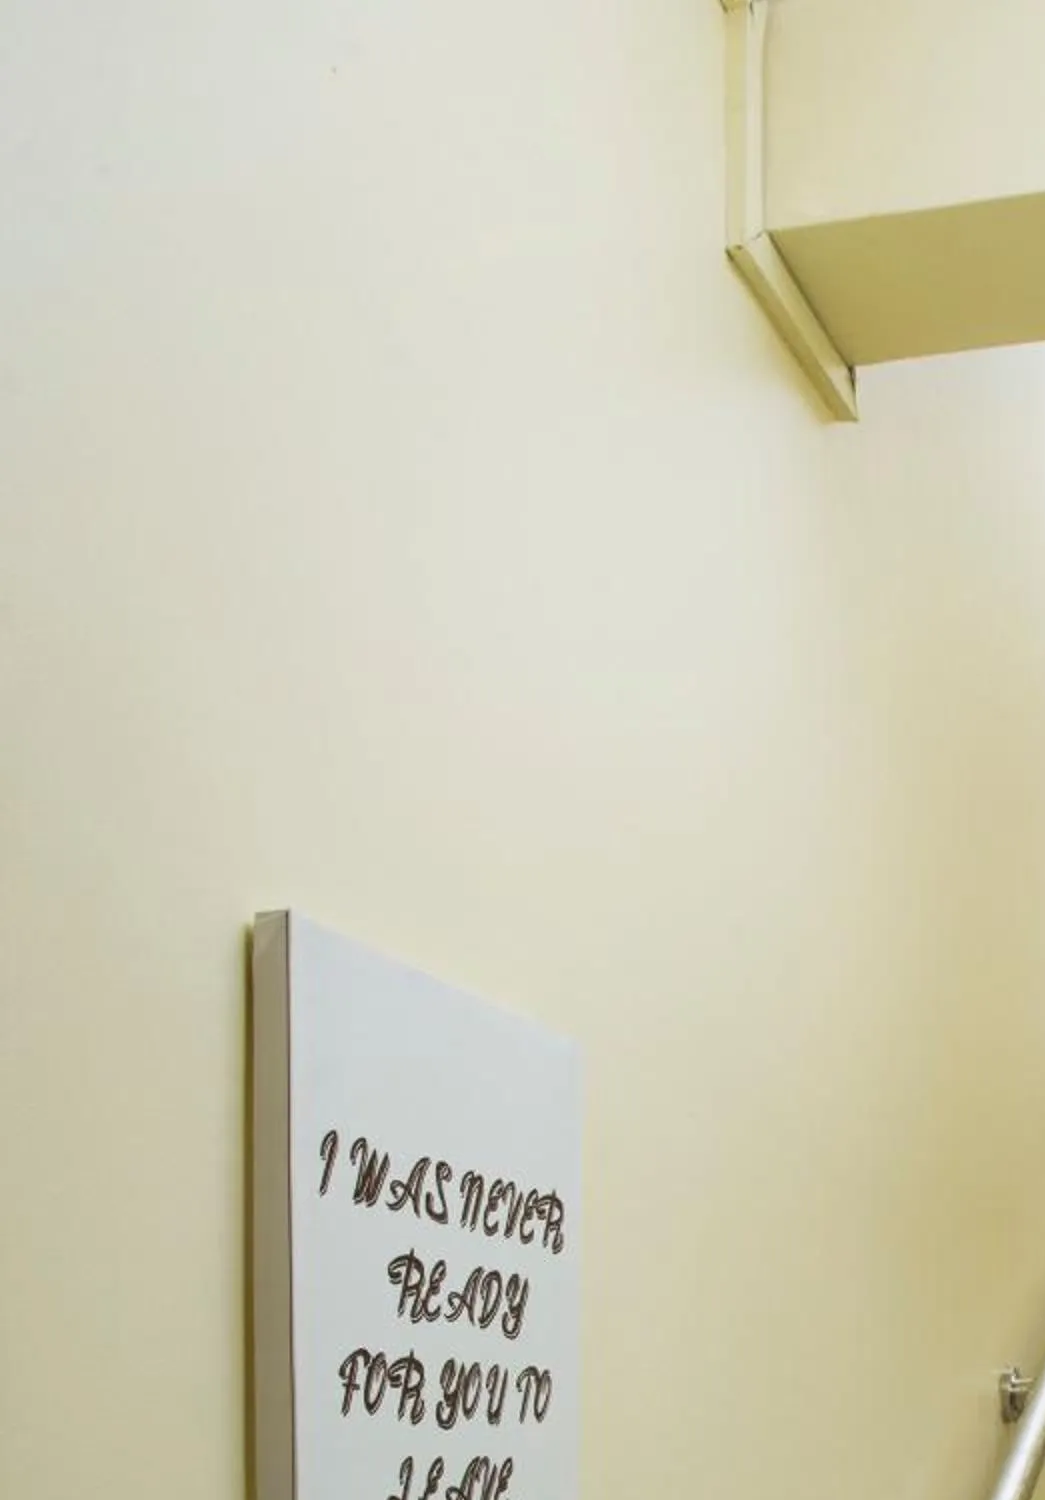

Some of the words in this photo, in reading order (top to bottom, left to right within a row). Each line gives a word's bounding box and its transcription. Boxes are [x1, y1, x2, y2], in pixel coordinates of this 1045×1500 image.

[319, 1129, 338, 1197] I
[349, 1136, 453, 1224] WAS
[459, 1170, 564, 1254] NEVER
[387, 1248, 529, 1340] READY
[338, 1347, 426, 1425] FOR
[435, 1357, 509, 1431] YOU
[516, 1365, 553, 1423] TO
